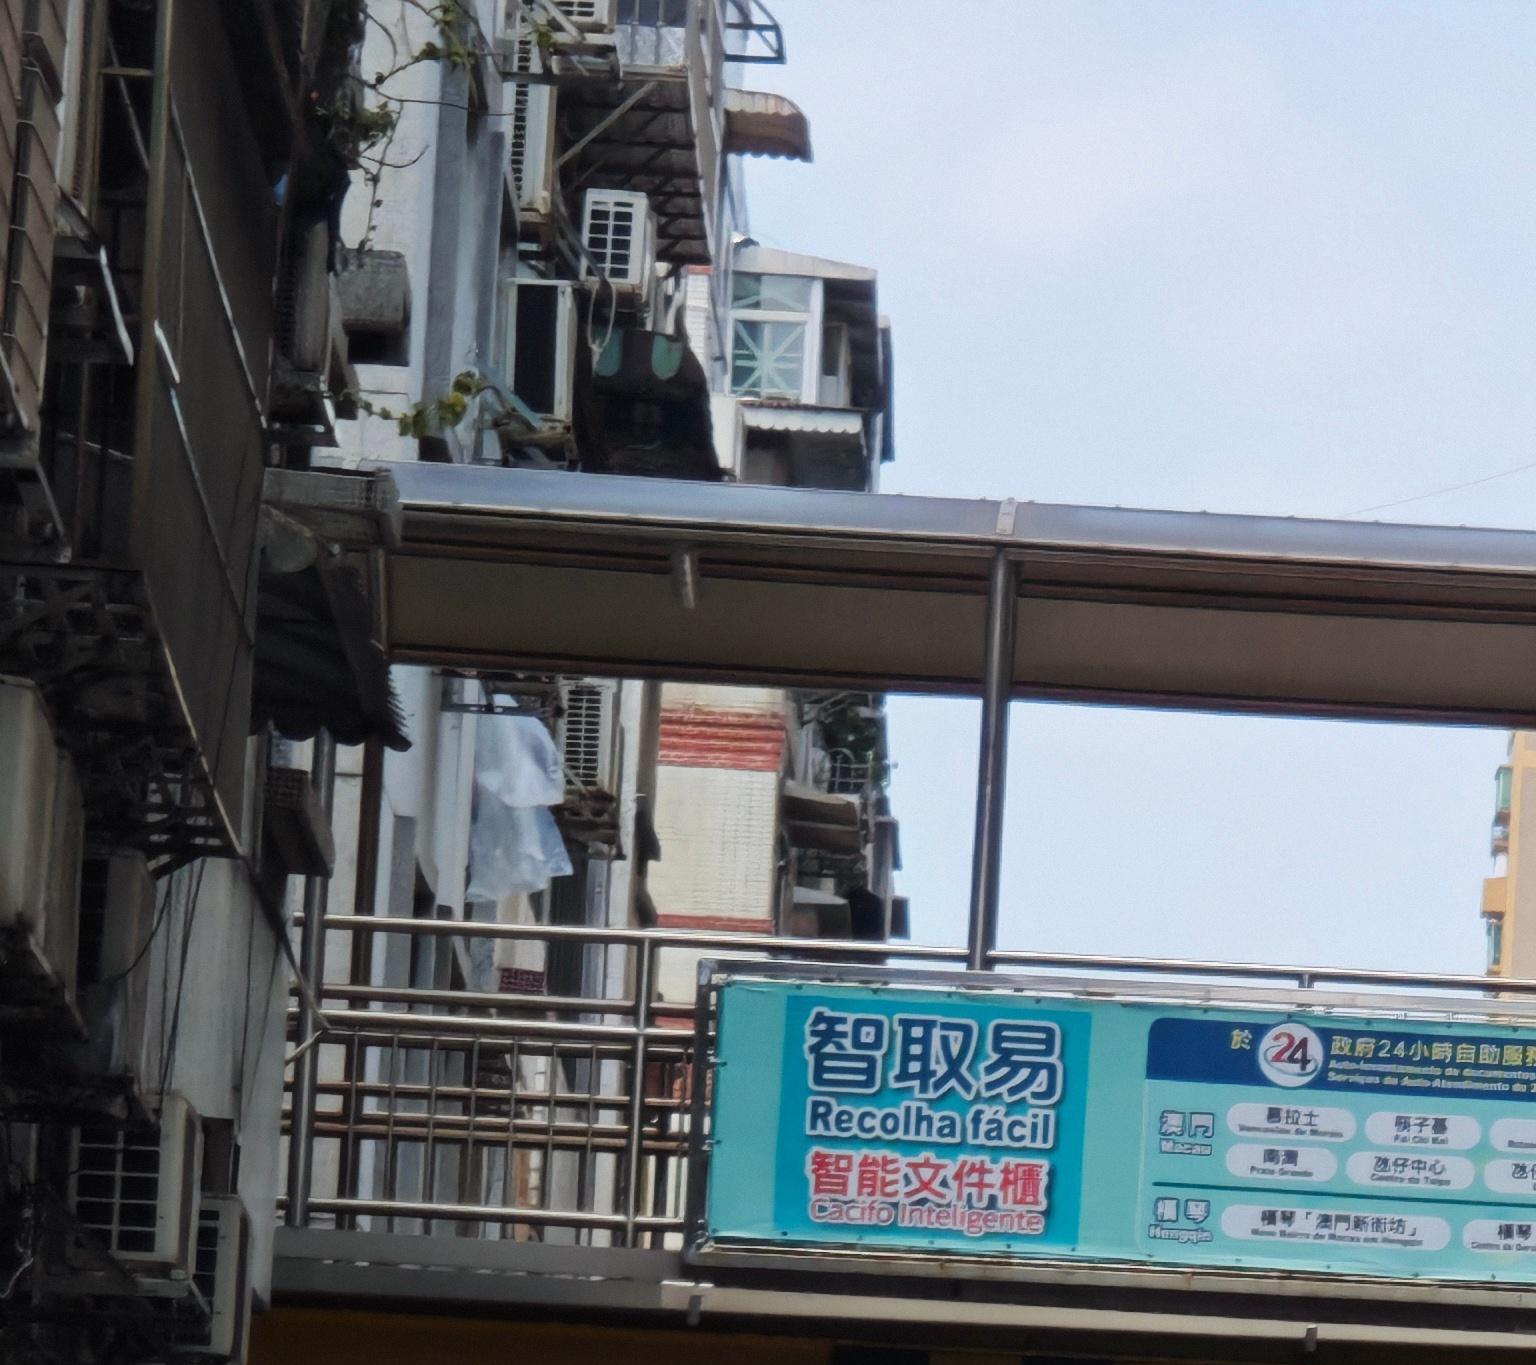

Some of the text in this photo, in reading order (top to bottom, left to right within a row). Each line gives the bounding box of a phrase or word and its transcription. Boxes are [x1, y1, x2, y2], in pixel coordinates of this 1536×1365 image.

[809, 1009, 1062, 1102] 智取易
[809, 1100, 1055, 1148] Recolha fácil
[811, 1152, 1046, 1207] 智能文件櫃
[810, 1198, 1045, 1235] Cacifo Inteligente
